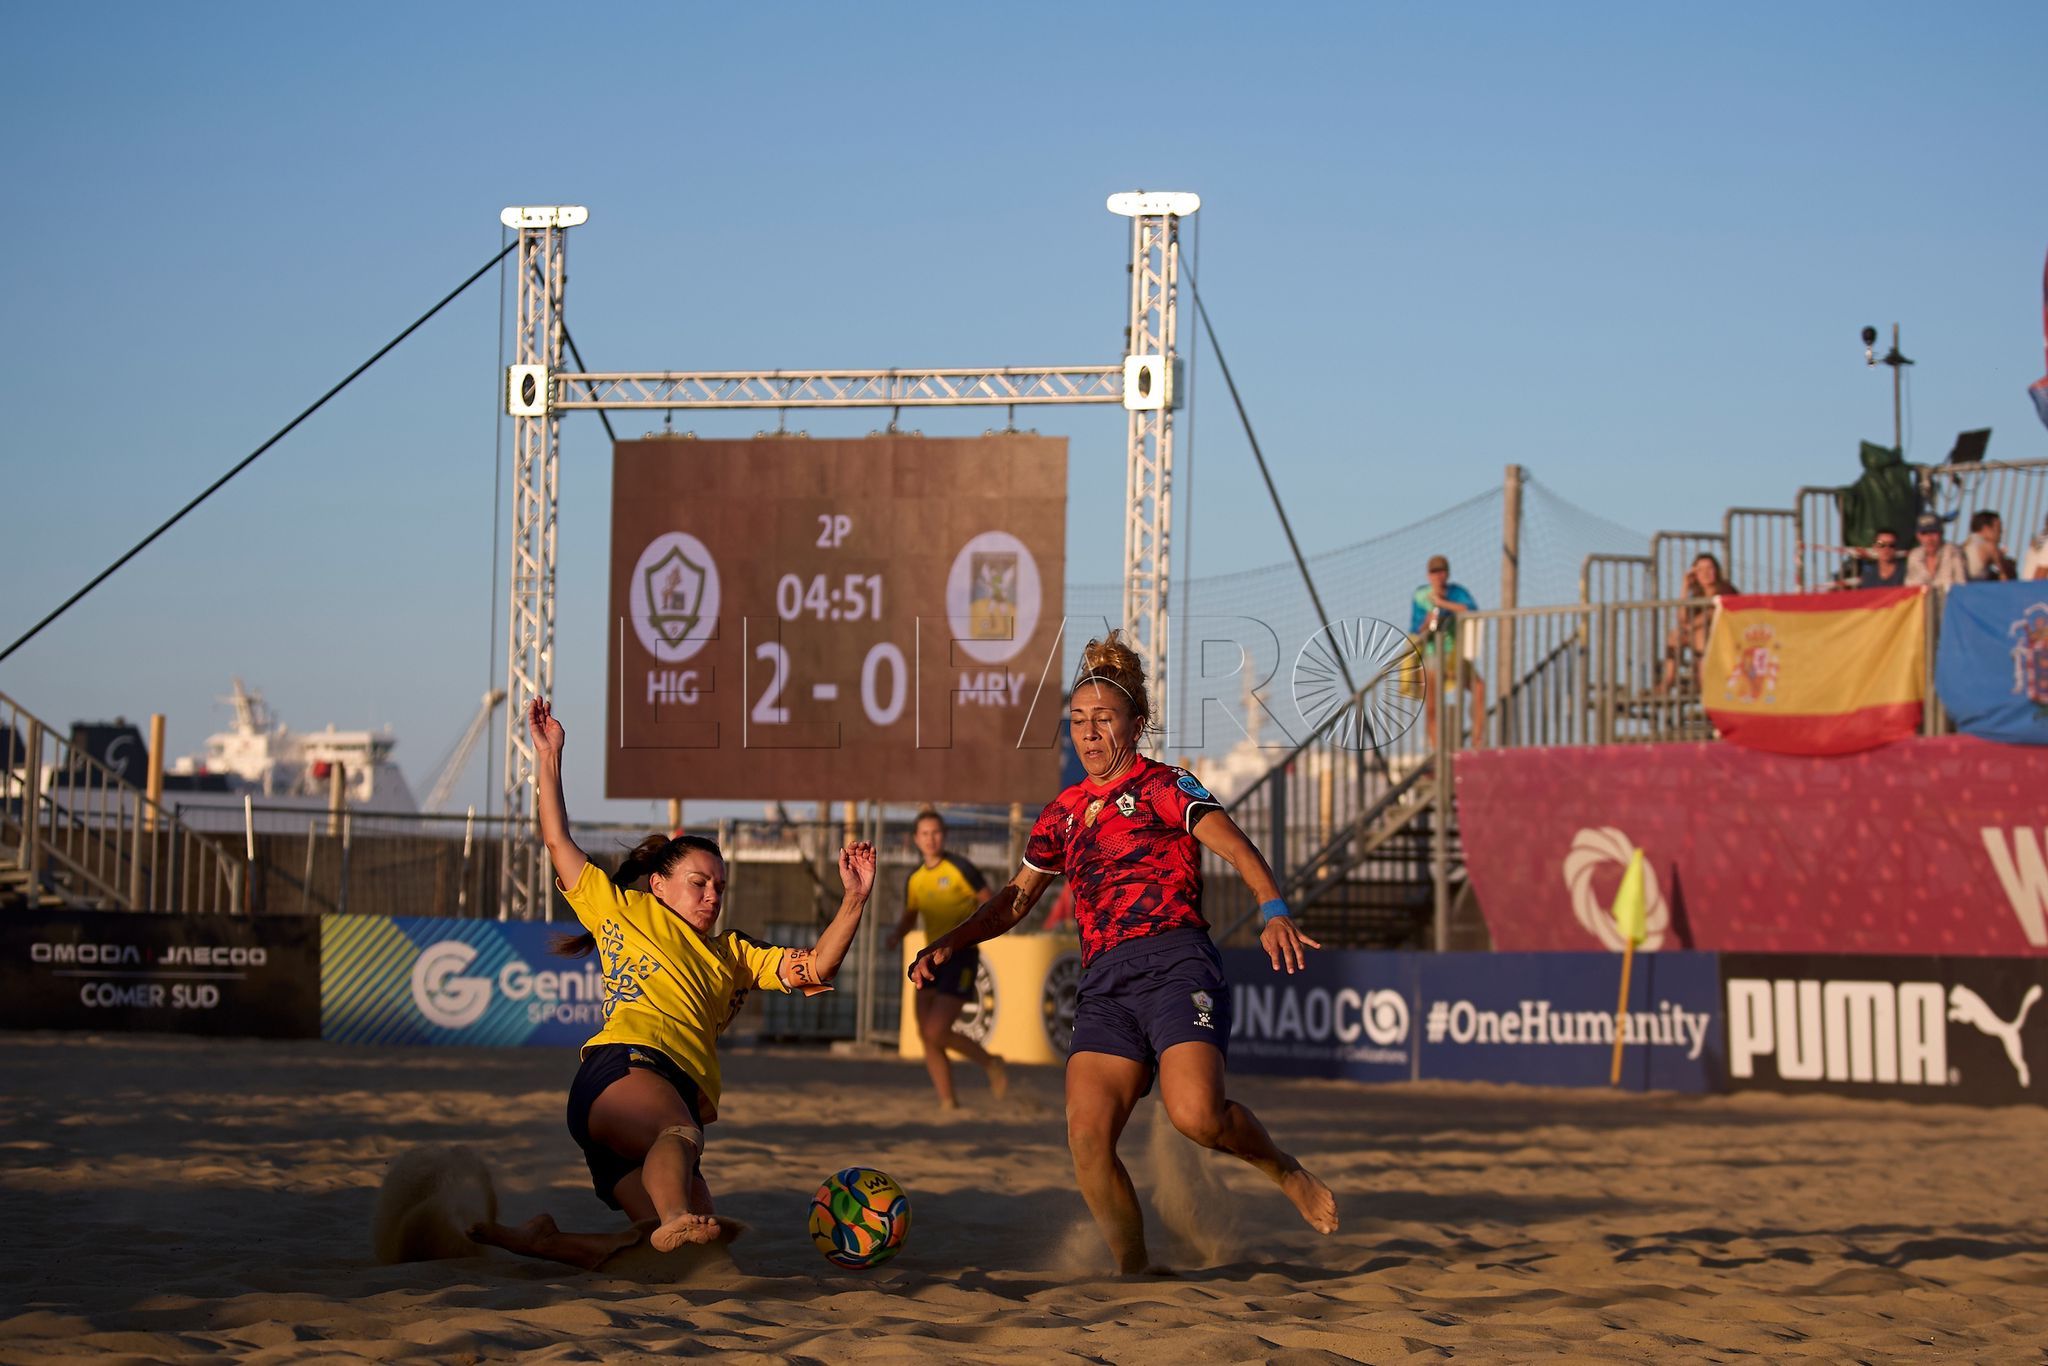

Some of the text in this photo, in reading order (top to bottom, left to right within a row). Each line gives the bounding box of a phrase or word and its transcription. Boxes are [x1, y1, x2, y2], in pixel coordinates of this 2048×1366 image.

[816, 514, 852, 548] 2P
[776, 573, 884, 622] 04:51
[646, 670, 701, 706] HIG
[751, 641, 791, 725] 2
[861, 641, 908, 727] 0
[957, 671, 1027, 707] MRY
[30, 942, 268, 966] OMODA JAECOO
[80, 982, 220, 1009] COMER SUD
[1425, 997, 1711, 1061] #OneHumanity
[1726, 977, 1948, 1086] PUMA
